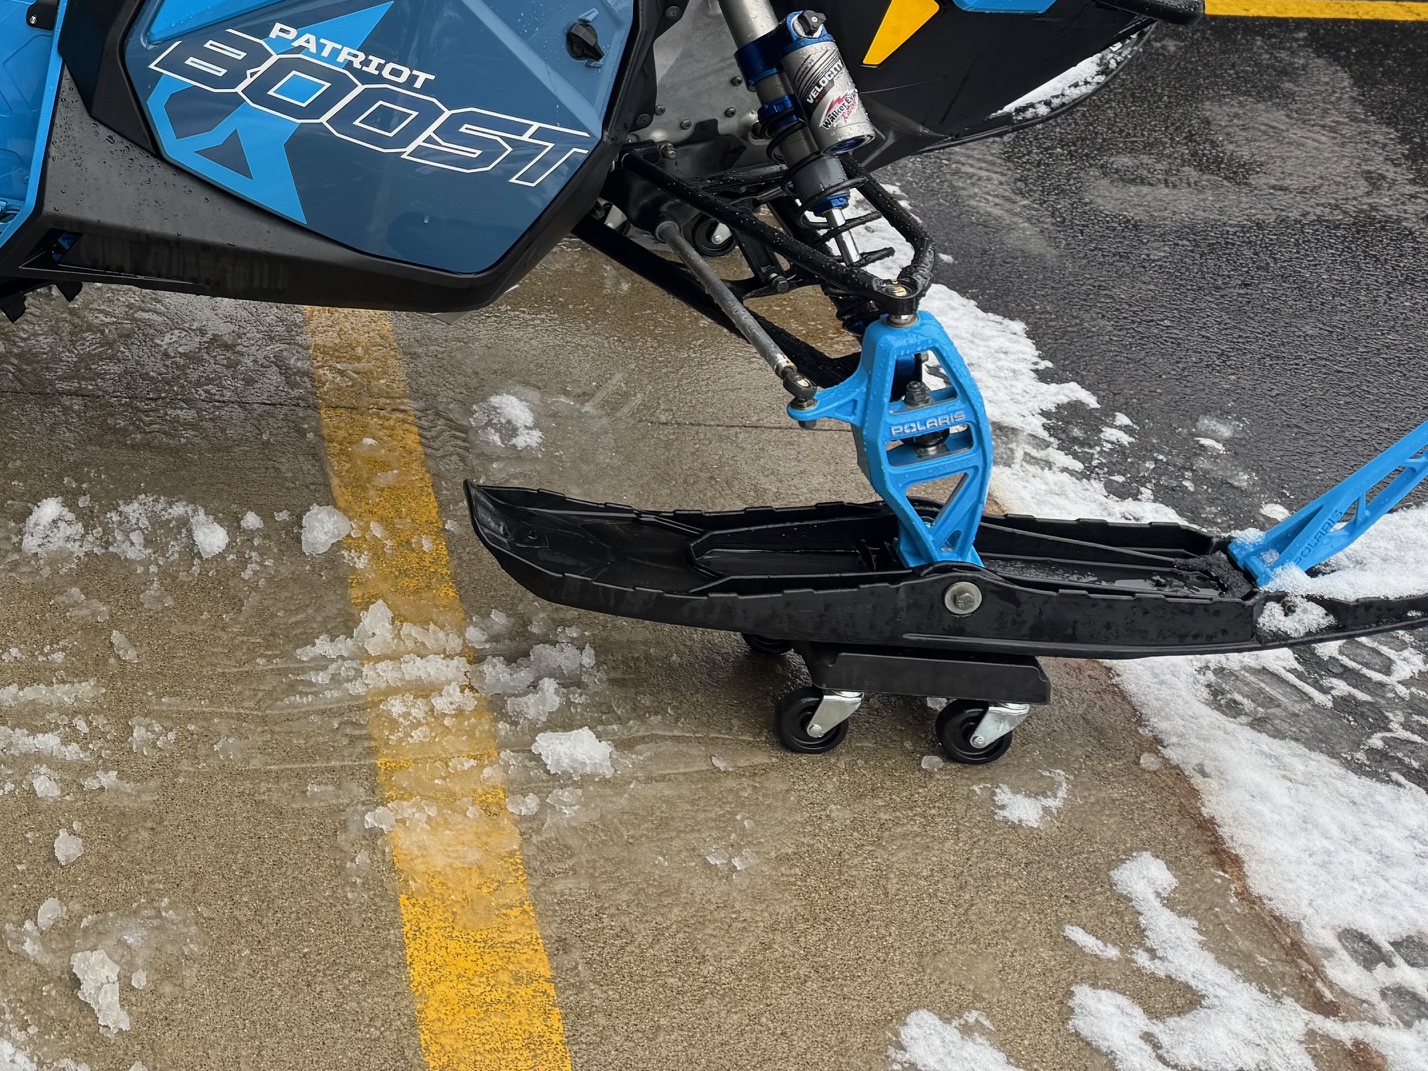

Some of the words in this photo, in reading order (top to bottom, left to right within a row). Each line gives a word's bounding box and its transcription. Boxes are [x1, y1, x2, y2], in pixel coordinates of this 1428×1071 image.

[268, 22, 436, 89] PATRIOT
[807, 60, 843, 104] VELOCITY
[149, 28, 590, 187] BOOST
[890, 410, 966, 436] POLARIS
[1293, 509, 1343, 565] POLARIS
